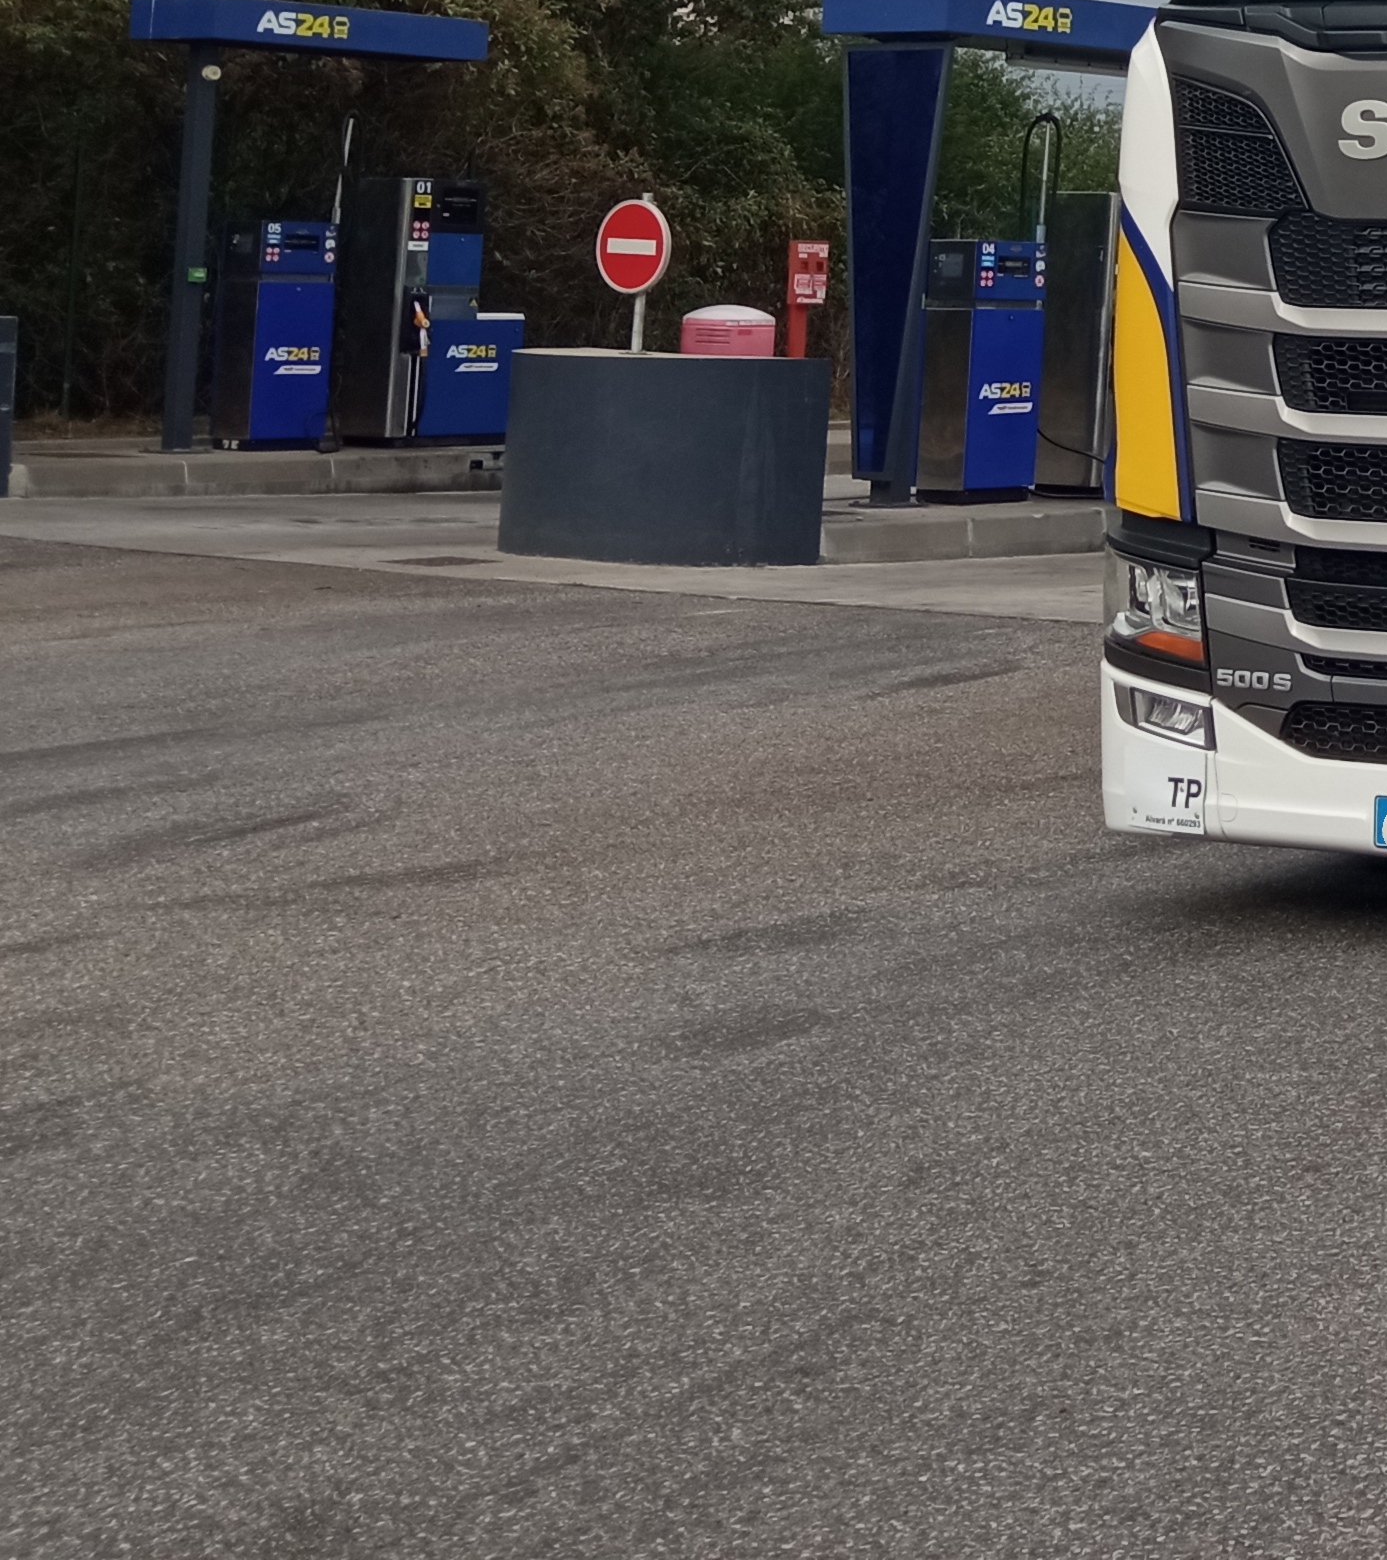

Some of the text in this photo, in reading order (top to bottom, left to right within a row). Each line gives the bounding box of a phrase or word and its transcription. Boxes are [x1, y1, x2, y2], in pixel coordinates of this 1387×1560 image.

[256, 9, 331, 39] AS24
[985, 0, 1055, 32] AS24
[416, 181, 432, 194] 01
[267, 223, 282, 234] 05
[264, 347, 309, 361] AS24
[446, 345, 487, 358] AS24
[979, 382, 1020, 399] AS24
[1216, 668, 1292, 692] 500 S
[1167, 776, 1203, 809] TP
